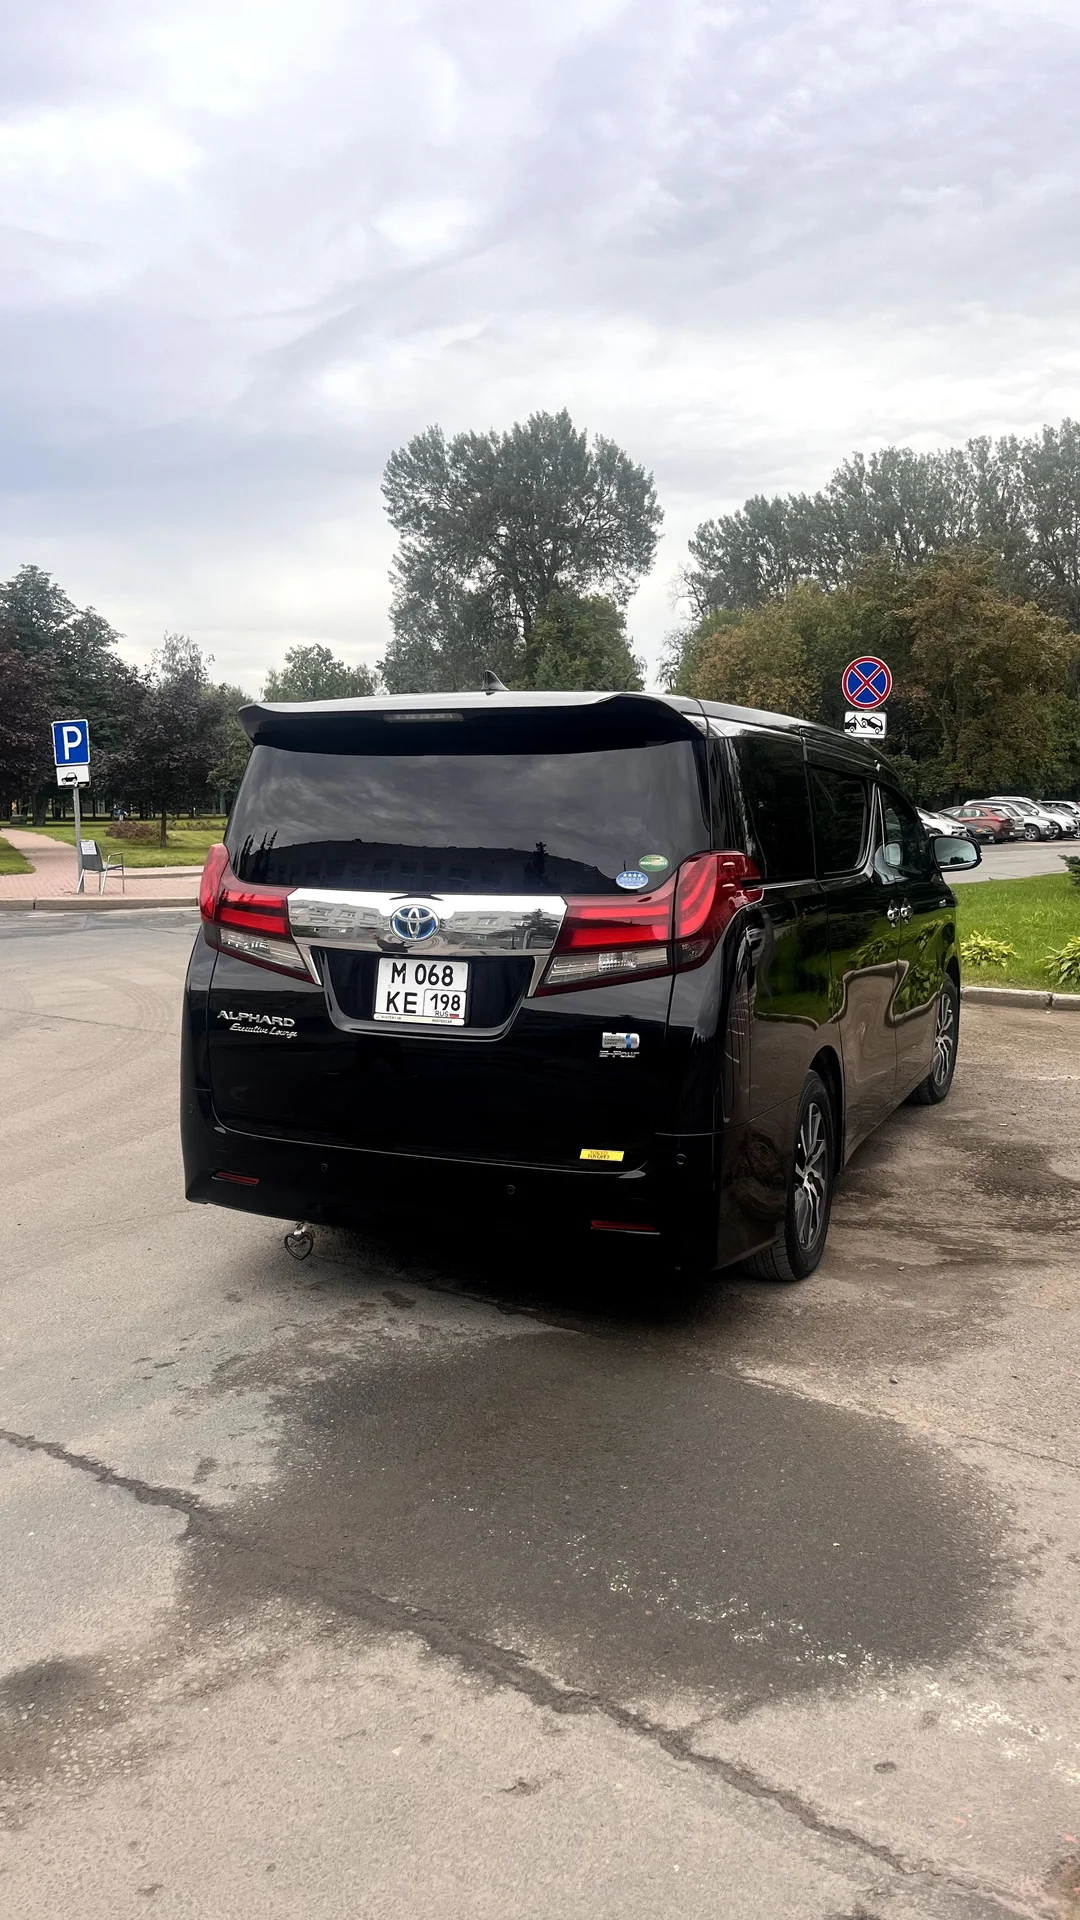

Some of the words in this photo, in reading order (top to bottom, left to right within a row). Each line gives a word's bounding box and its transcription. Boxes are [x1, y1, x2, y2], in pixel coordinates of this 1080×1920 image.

[62, 726, 82, 760] P
[414, 963, 454, 987] 068
[430, 993, 461, 1012] 198
[217, 1010, 295, 1027] ALPHARD
